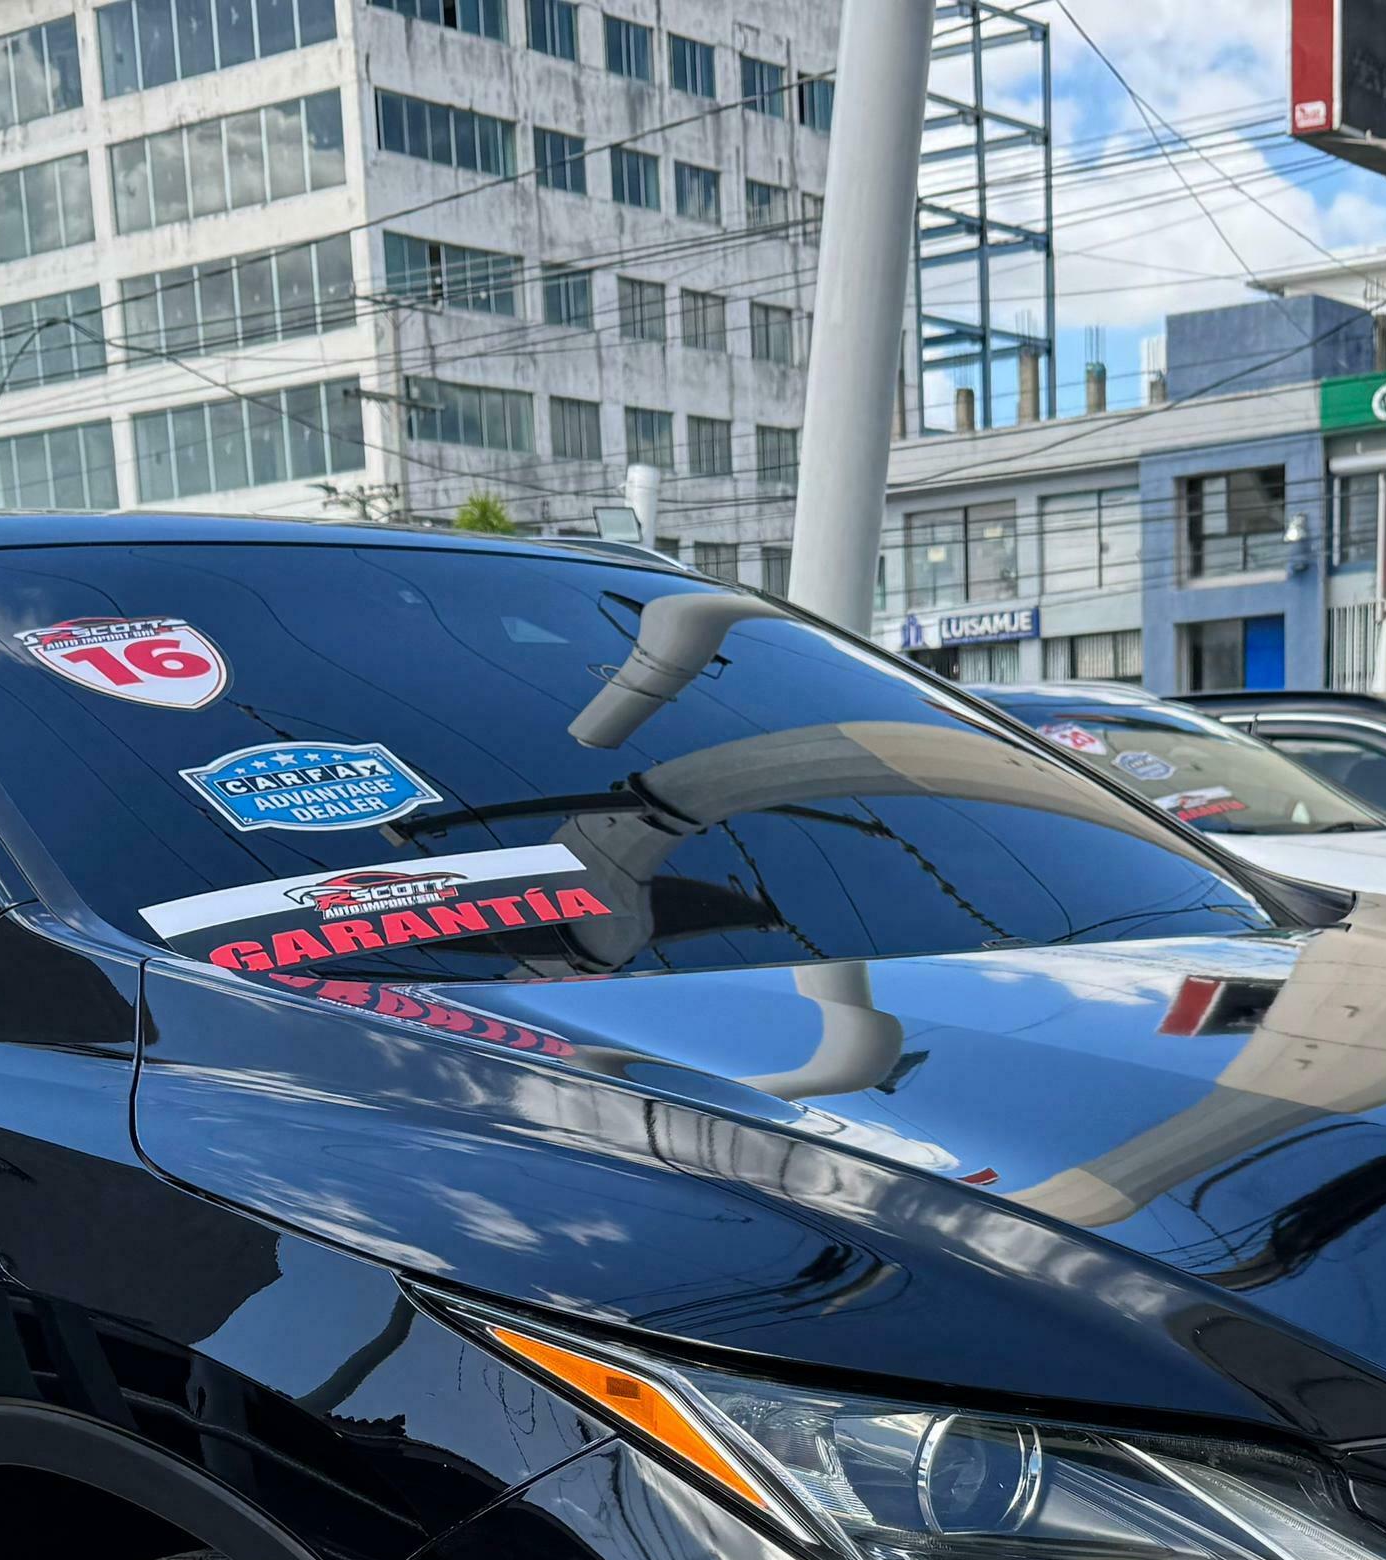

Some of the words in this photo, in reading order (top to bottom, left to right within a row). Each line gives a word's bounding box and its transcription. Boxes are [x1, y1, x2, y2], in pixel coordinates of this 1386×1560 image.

[61, 639, 211, 685] 16
[224, 763, 384, 794] CARFAX
[254, 780, 396, 811] ADVANTAGE
[291, 797, 389, 822] DEALER
[210, 887, 612, 971] GARANTÍA
